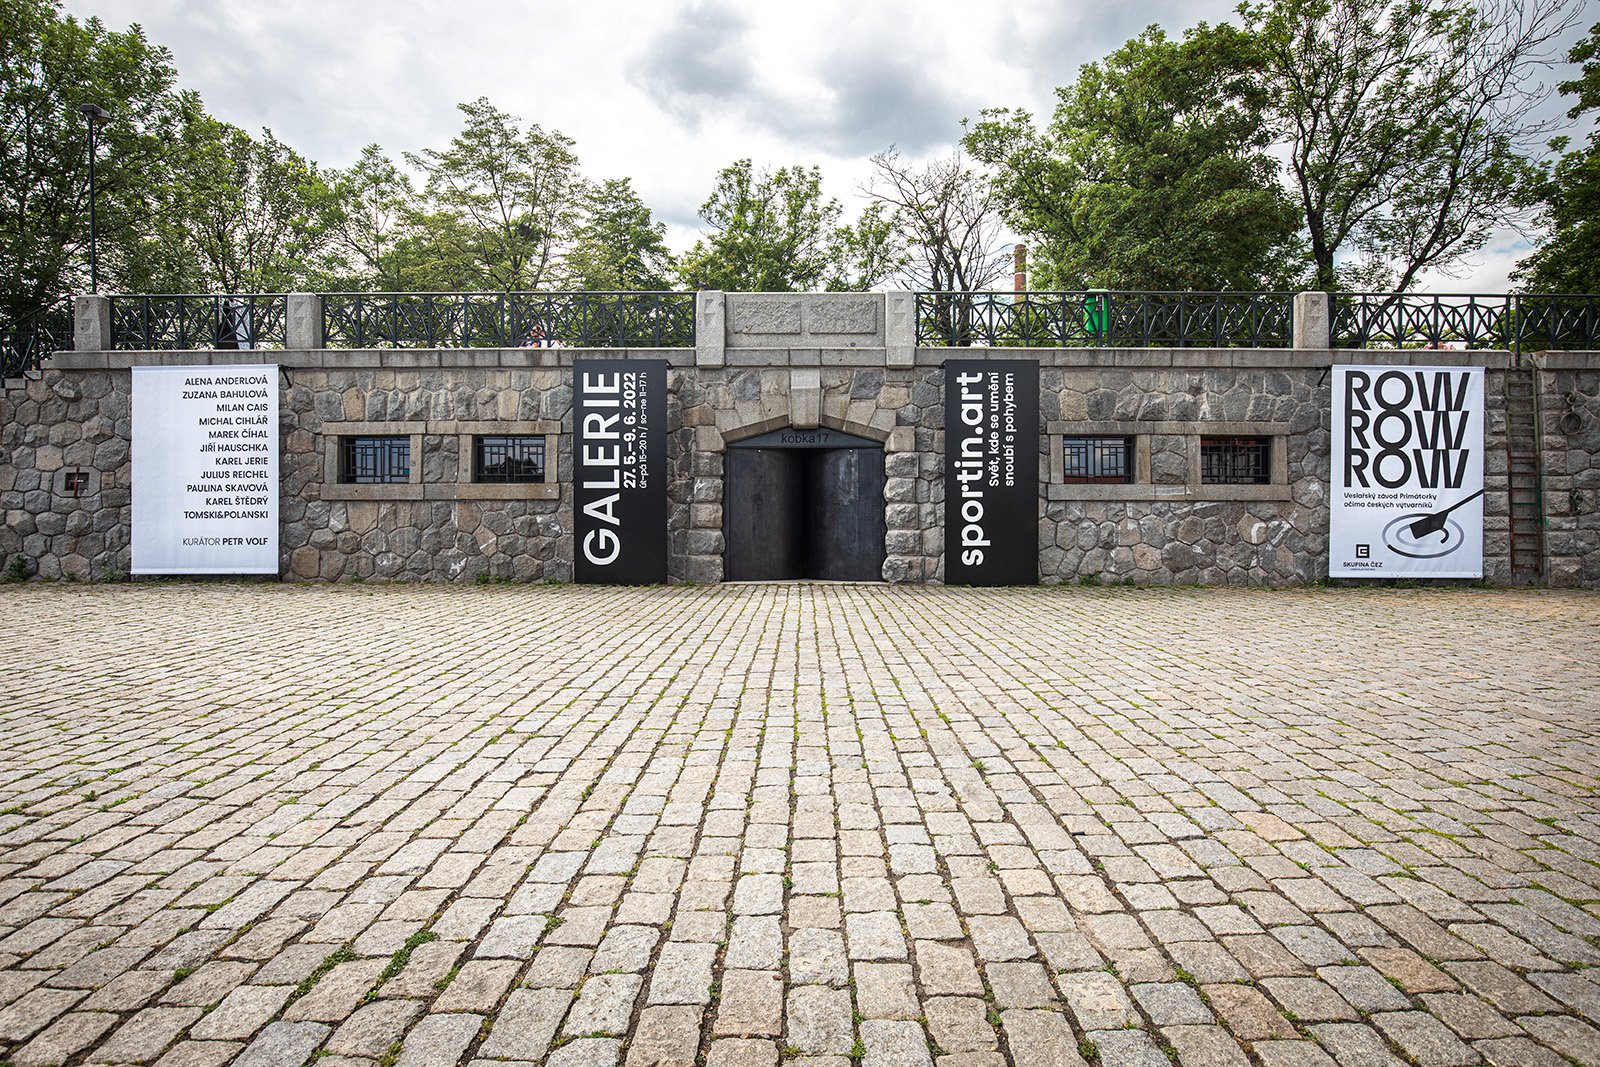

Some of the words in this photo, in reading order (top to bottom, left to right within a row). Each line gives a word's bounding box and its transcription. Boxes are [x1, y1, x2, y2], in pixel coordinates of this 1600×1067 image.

[184, 376, 213, 386] ALENA
[214, 374, 269, 386] ANDERLOVÁ
[182, 390, 218, 400] ZUZANA
[220, 386, 269, 399] BAHULOVÁ
[623, 372, 637, 409] 2022
[988, 371, 999, 412] umění
[1345, 370, 1471, 411] ROW
[216, 403, 245, 412] MILAN
[246, 403, 269, 412] CAIS
[1003, 372, 1017, 432] pohybem
[198, 417, 234, 426] MICHAL
[235, 415, 269, 426] CIHLÁŘ
[623, 411, 637, 426] 6.
[990, 414, 999, 429] se
[208, 430, 240, 439] MAREK
[241, 428, 269, 439] ČÍHAL
[1345, 410, 1470, 450] ROW
[781, 432, 830, 444] kobka17
[988, 431, 999, 455] kde
[200, 442, 216, 453] JIŘÍ
[217, 443, 269, 452] HAUSCHKA
[215, 457, 243, 466] KAREL
[244, 456, 269, 466] JERIE
[1003, 444, 1014, 487] snoubí
[200, 470, 231, 479] JULIUS
[232, 470, 269, 479] REICHEL
[583, 372, 621, 566] GALERIE
[954, 371, 991, 566] sportin.art
[988, 457, 1001, 487] Svět,
[1344, 448, 1470, 489] ROW
[623, 468, 637, 489] 27.
[186, 484, 223, 493] PAULINA
[225, 481, 269, 493] SKAVOVÁ
[205, 497, 233, 506] KAREL
[235, 495, 269, 506] ŠTĚDRÝ
[1344, 492, 1376, 500] Veslařský
[1377, 492, 1398, 500] závod
[1399, 493, 1437, 501] Primátorky
[1367, 501, 1394, 509] českých
[183, 511, 269, 520] TOMSKI&POLANSKI
[182, 535, 221, 546] KURÁTOR
[222, 537, 244, 546] PETR
[245, 537, 269, 546] VOLF
